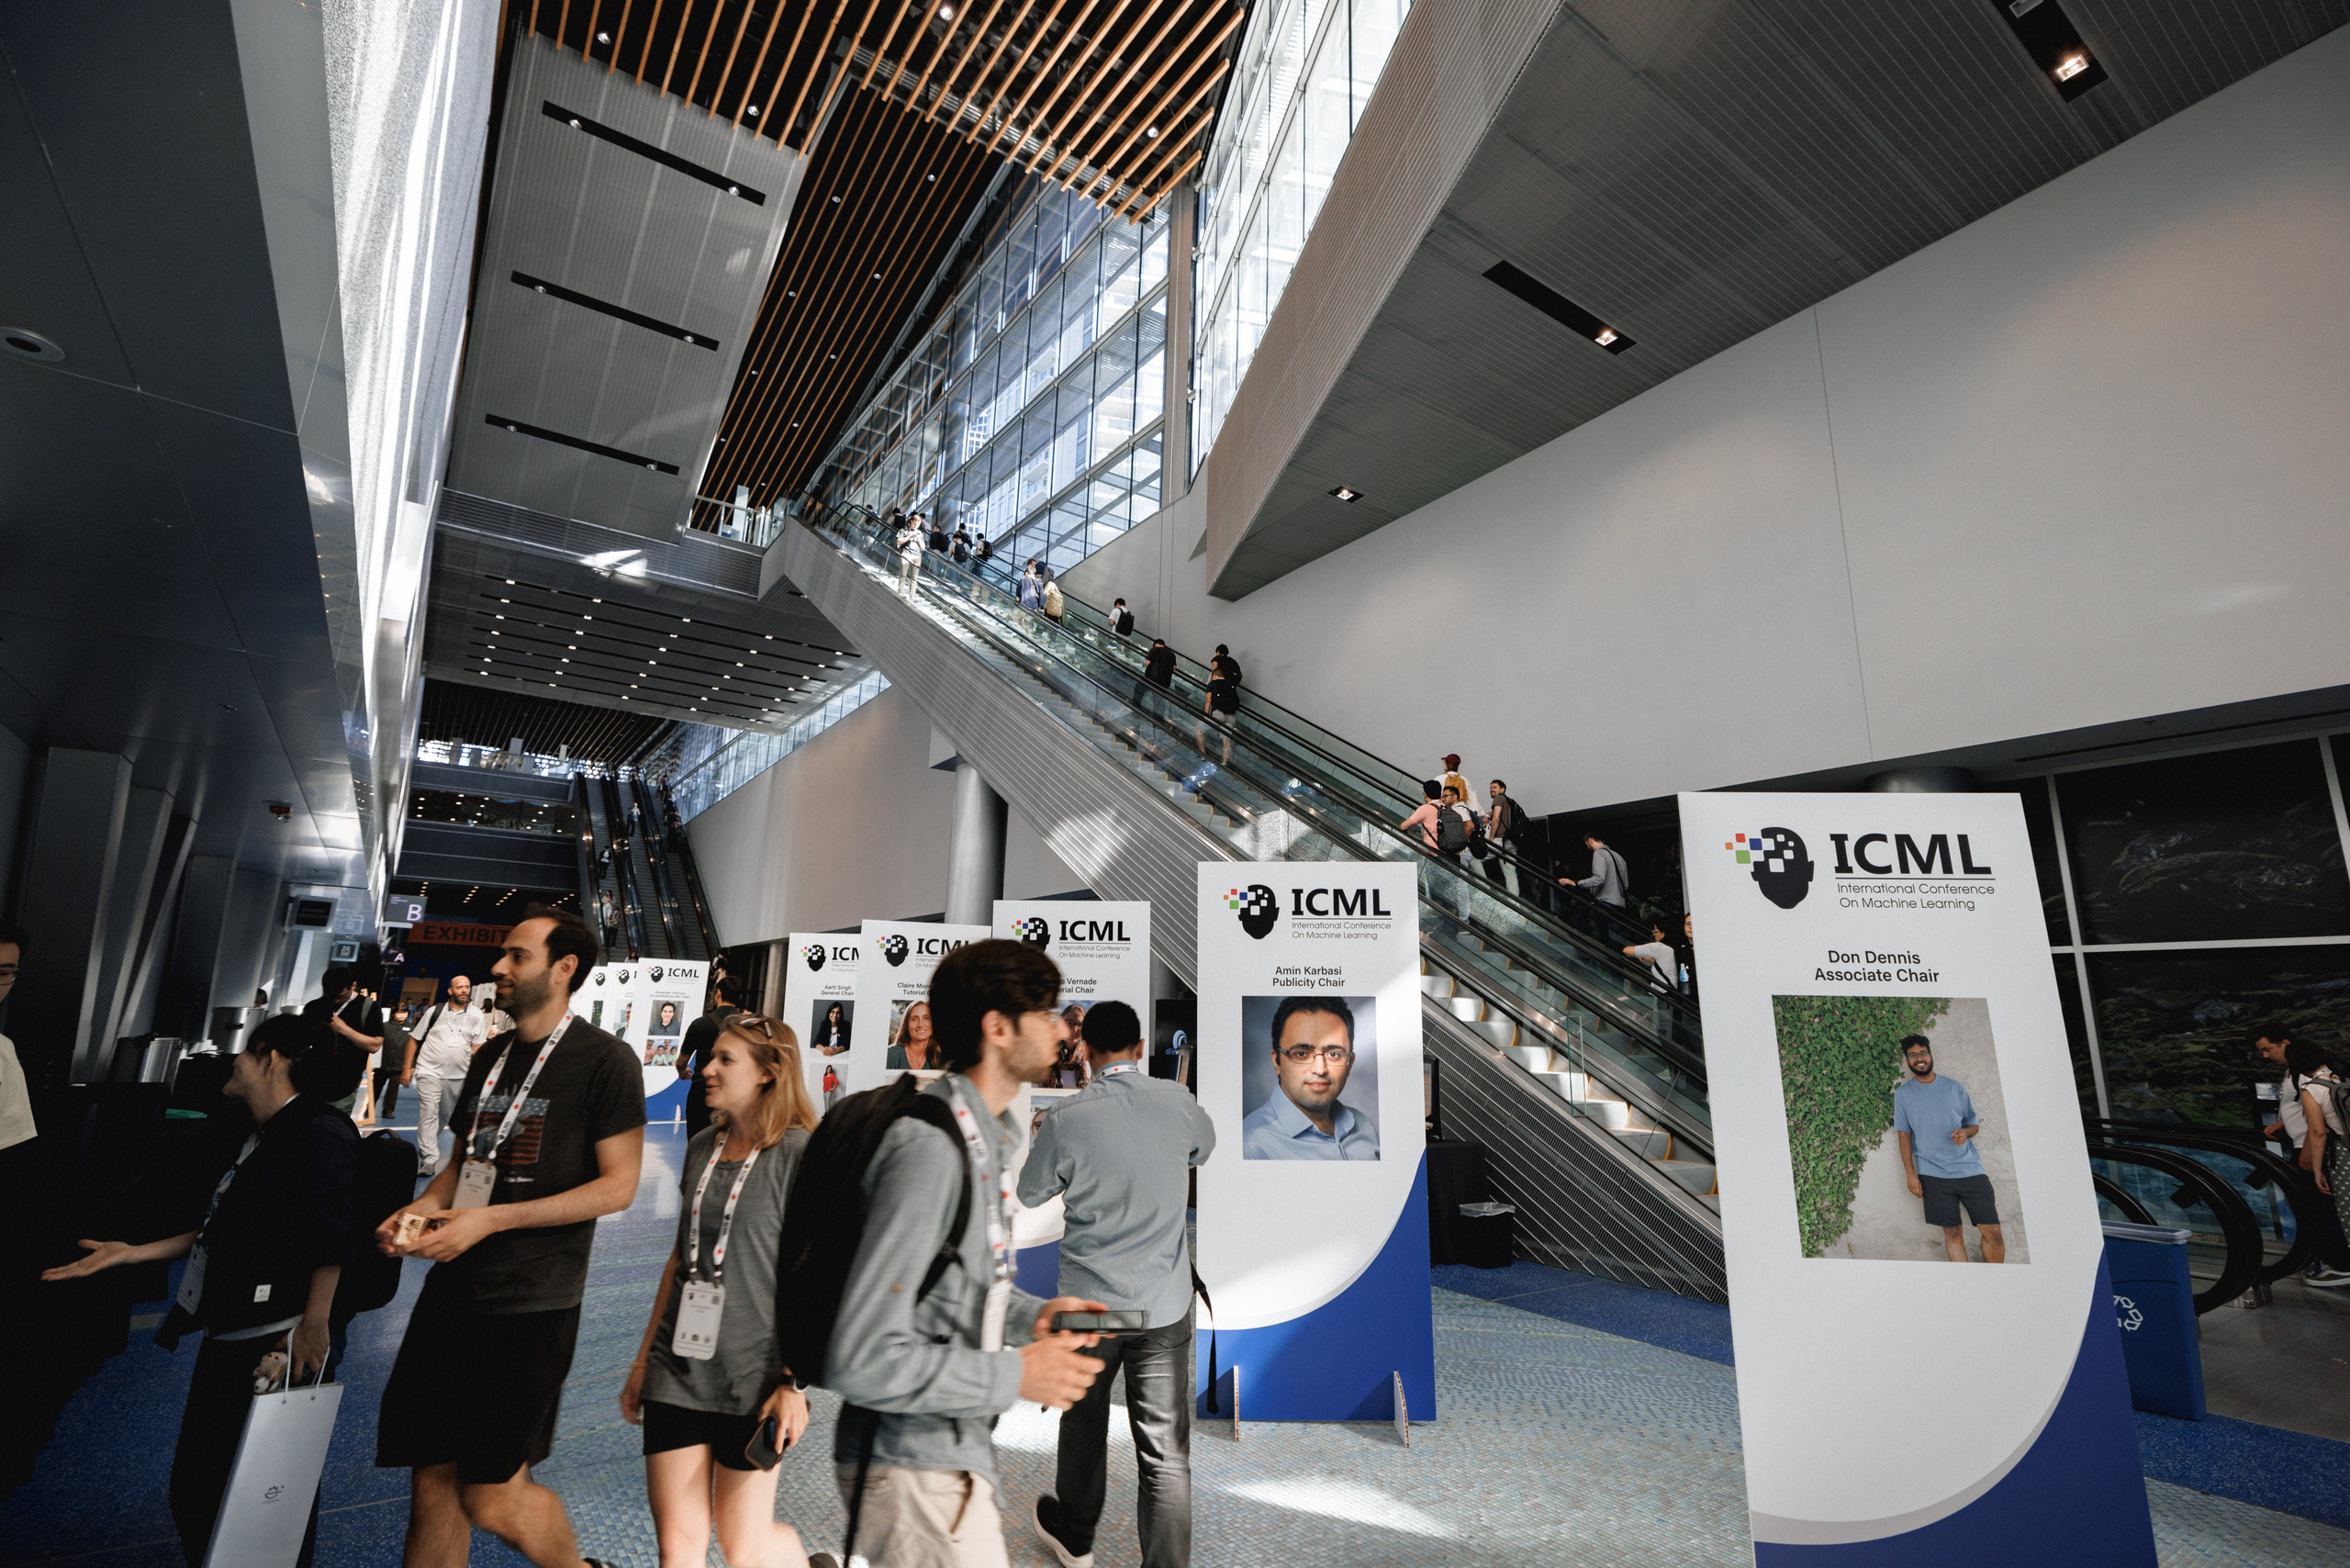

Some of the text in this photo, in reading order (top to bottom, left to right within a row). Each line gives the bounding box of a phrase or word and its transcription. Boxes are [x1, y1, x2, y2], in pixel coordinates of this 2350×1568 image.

[1830, 833, 1992, 874] ICML
[1837, 882, 1995, 895] International Conference
[1292, 888, 1391, 916] ICML
[1839, 897, 1975, 912] On Machine Learning
[407, 903, 422, 921] B
[1059, 920, 1131, 942] ICML
[1292, 921, 1392, 930] International Conference
[1292, 931, 1378, 941] On Machine Learning
[394, 953, 405, 962] A
[1828, 950, 1921, 965] Don Dennis
[667, 968, 699, 978] ICML
[1275, 966, 1342, 976] Amin Karbasi
[1814, 968, 1940, 982] Associate Chair
[1272, 977, 1346, 989] Publicity Chair
